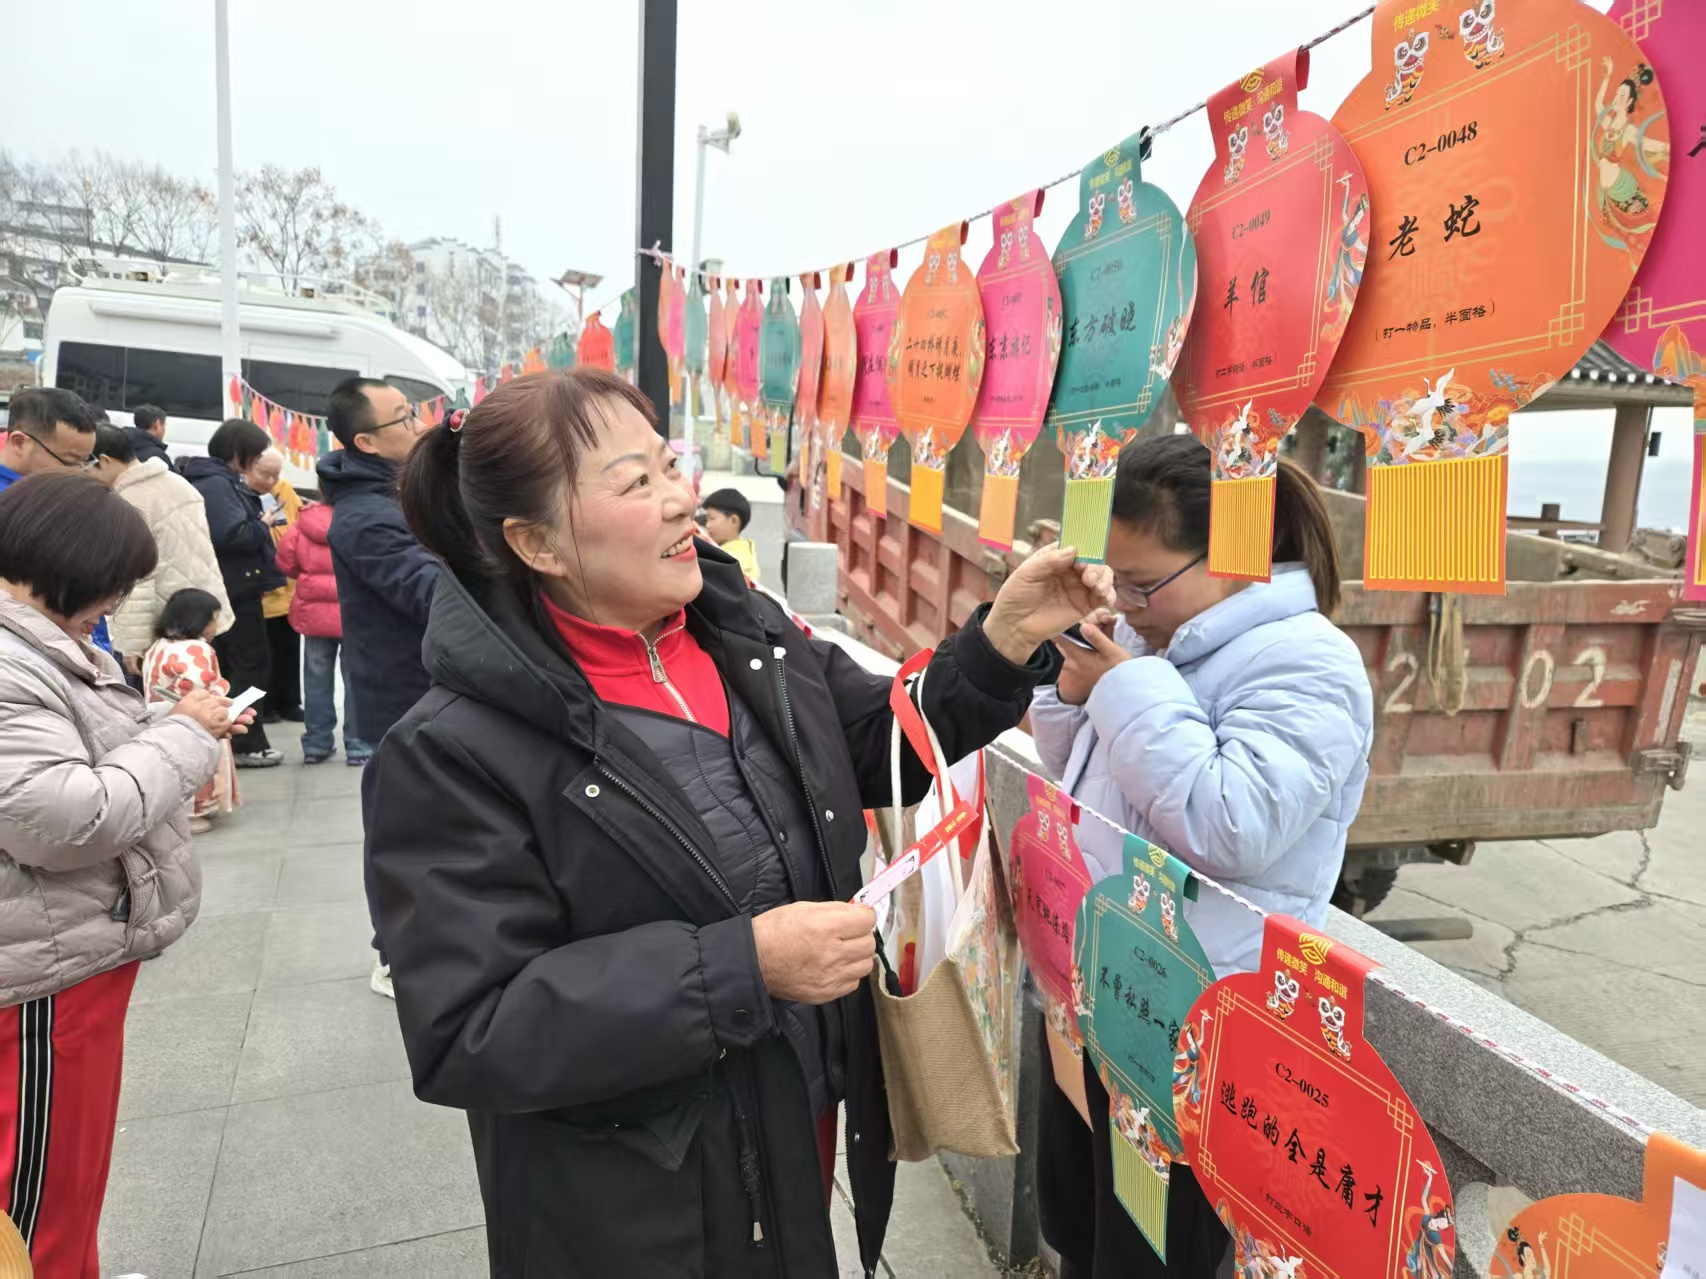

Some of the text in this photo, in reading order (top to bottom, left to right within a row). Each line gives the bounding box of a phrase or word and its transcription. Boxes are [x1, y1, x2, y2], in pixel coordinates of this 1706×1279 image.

[1404, 121, 1478, 166] C2-0048
[1231, 209, 1271, 240] C2-0049
[1387, 195, 1481, 262] 老蛇
[1069, 301, 1136, 347] 东方破晓
[1134, 946, 1168, 978] C2-0026
[1276, 947, 1348, 999] 传递微笑 沟通和谐
[1275, 1062, 1330, 1107] C2-0025
[1220, 1081, 1385, 1228] 逃跑的全是庸才
